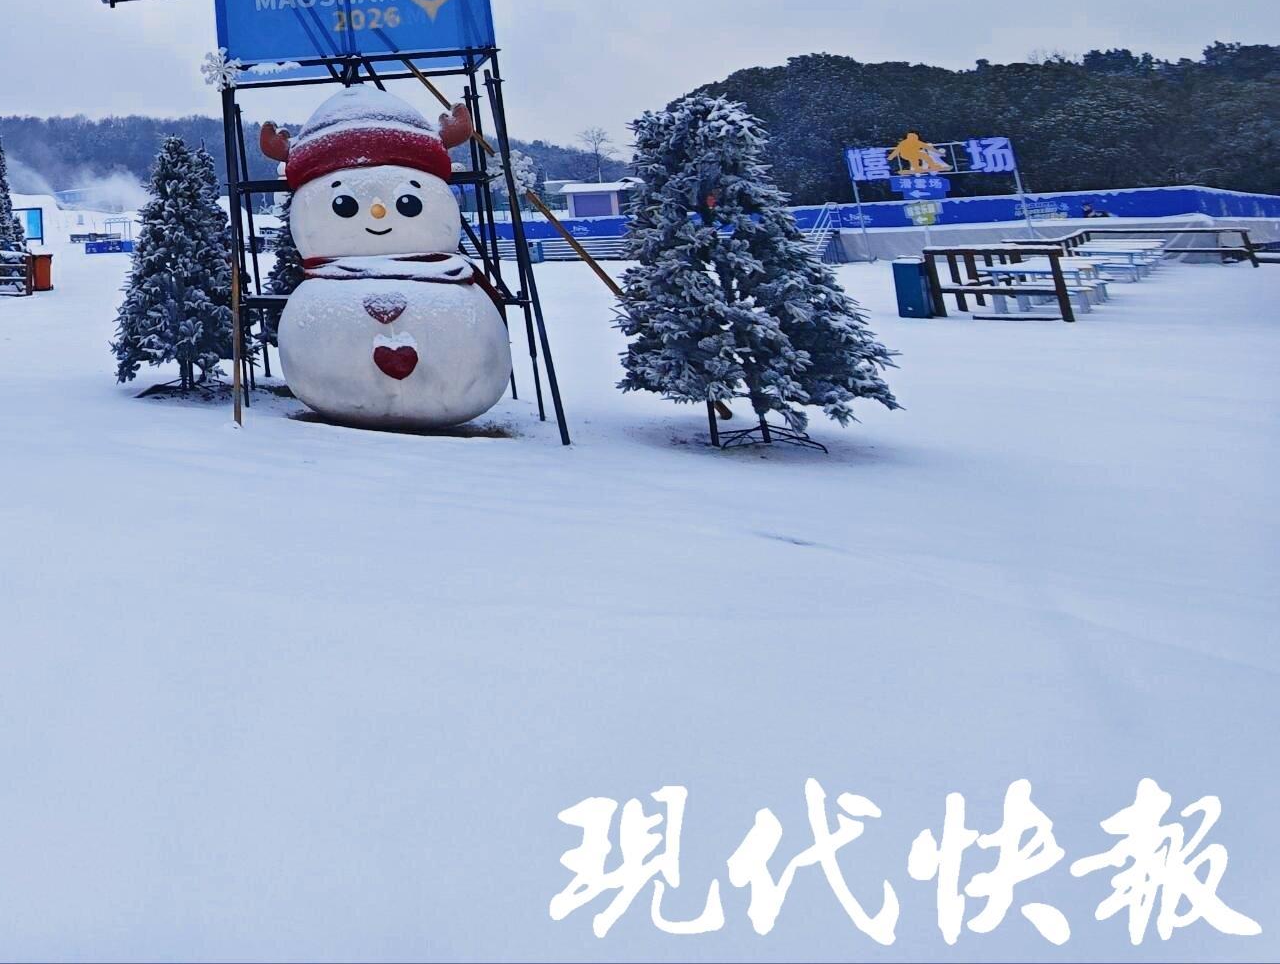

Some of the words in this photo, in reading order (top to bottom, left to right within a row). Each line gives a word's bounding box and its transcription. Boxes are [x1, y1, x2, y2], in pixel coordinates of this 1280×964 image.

[333, 6, 400, 32] 2026
[847, 136, 1016, 181] 嬉场
[899, 178, 943, 189] 滑雪场
